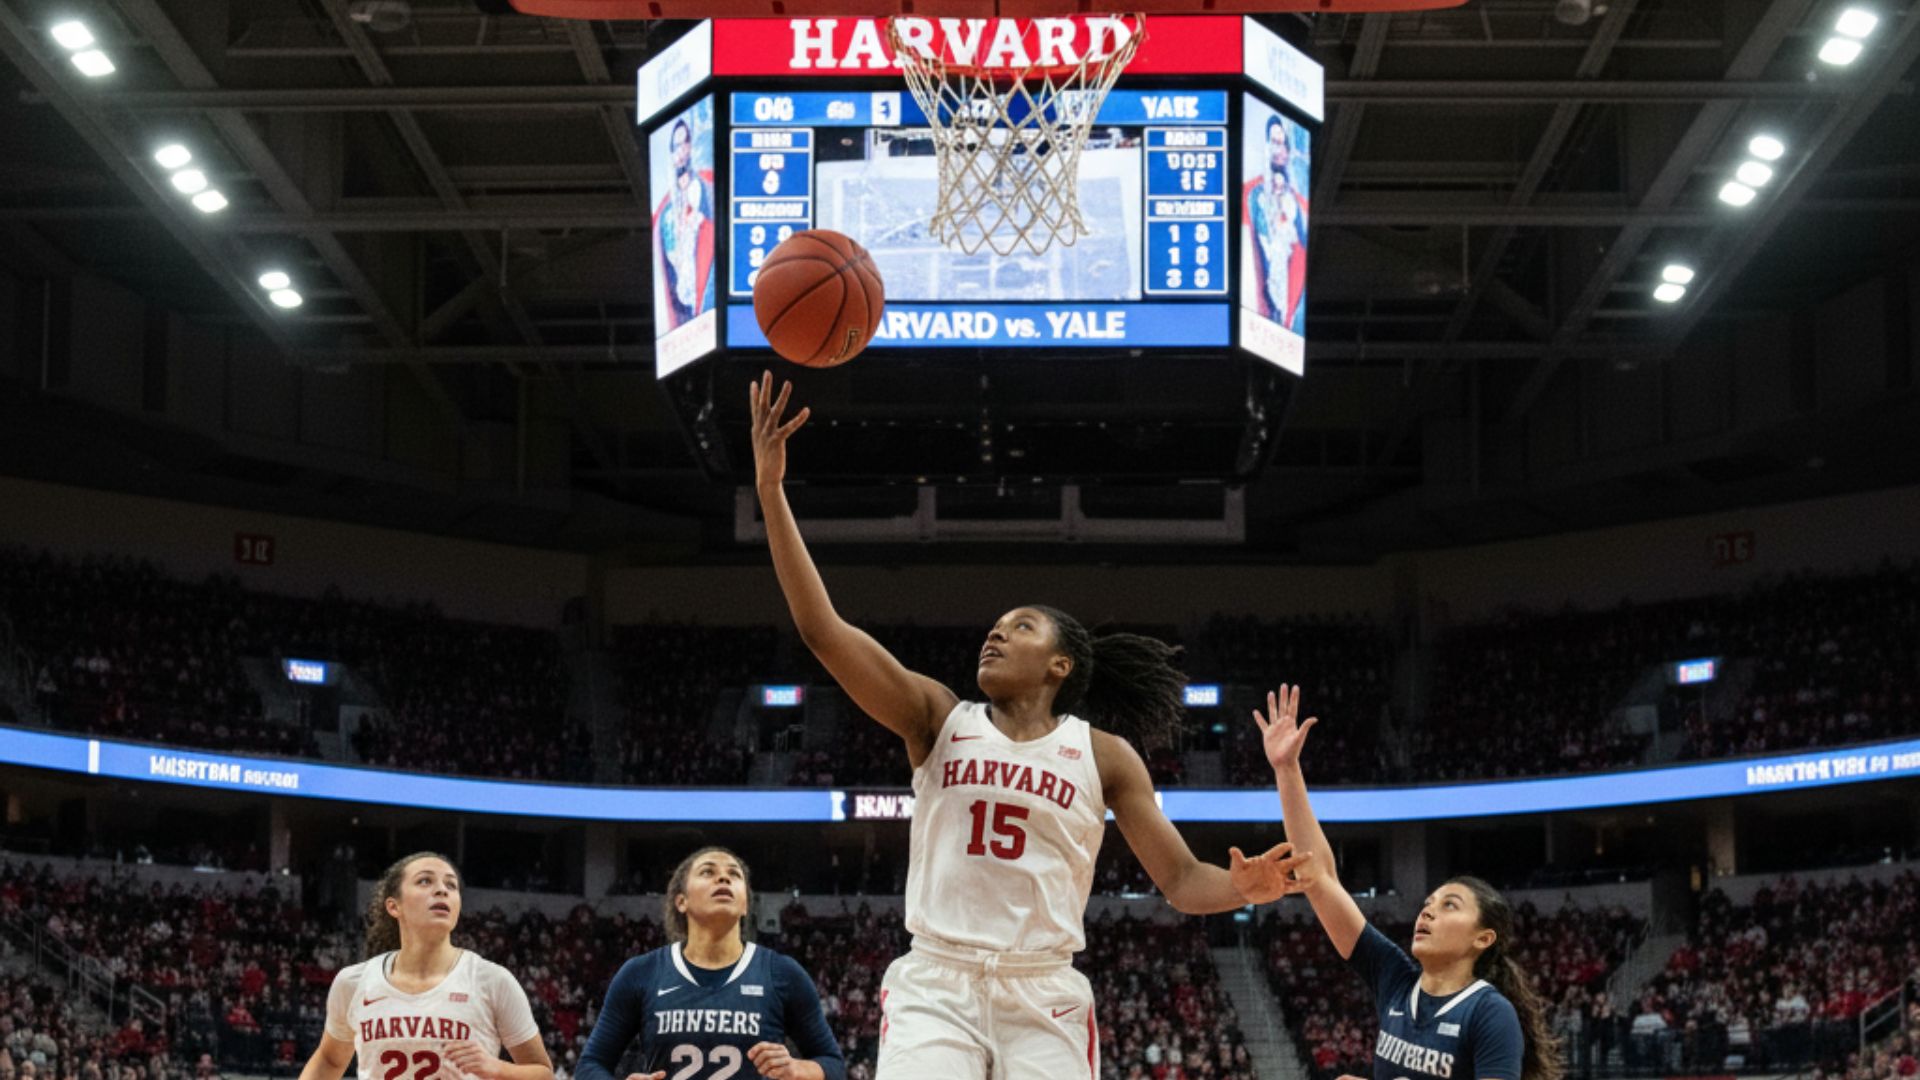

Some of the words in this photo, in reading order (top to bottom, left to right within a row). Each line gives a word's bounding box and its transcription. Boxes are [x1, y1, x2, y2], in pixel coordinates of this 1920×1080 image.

[789, 18, 1132, 69] HARVARD
[872, 311, 996, 338] ARVARD
[1004, 317, 1041, 338] vs.
[1046, 311, 1126, 338] YALE
[942, 759, 1076, 810] HARVARD
[967, 799, 1030, 860] 15
[380, 1050, 440, 1080] 22
[670, 1044, 742, 1080] 22
